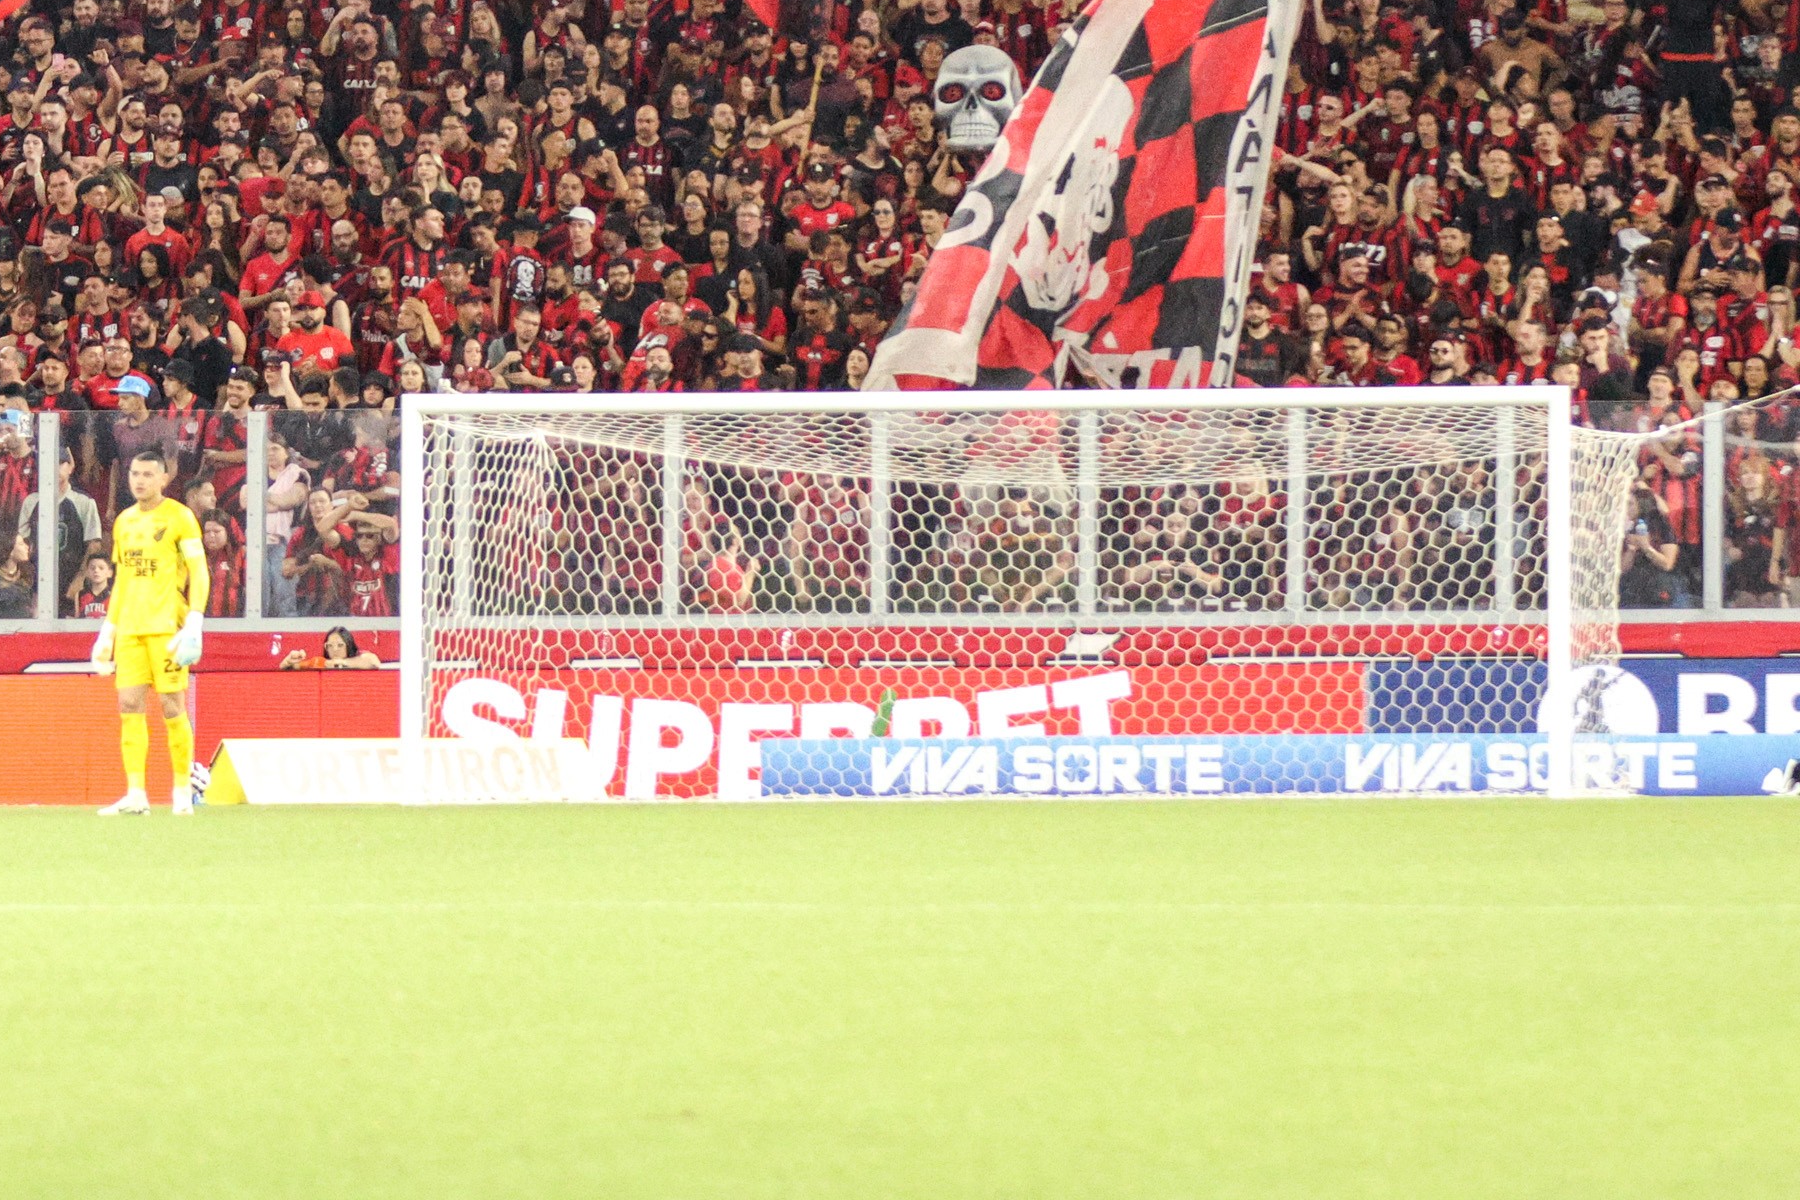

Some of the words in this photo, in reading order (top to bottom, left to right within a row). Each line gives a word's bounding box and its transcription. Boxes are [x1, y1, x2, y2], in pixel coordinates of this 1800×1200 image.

[135, 567, 158, 577] BET
[871, 746, 998, 793] VIVA
[1013, 745, 1224, 792] SORTE
[1345, 743, 1472, 790] VIVA
